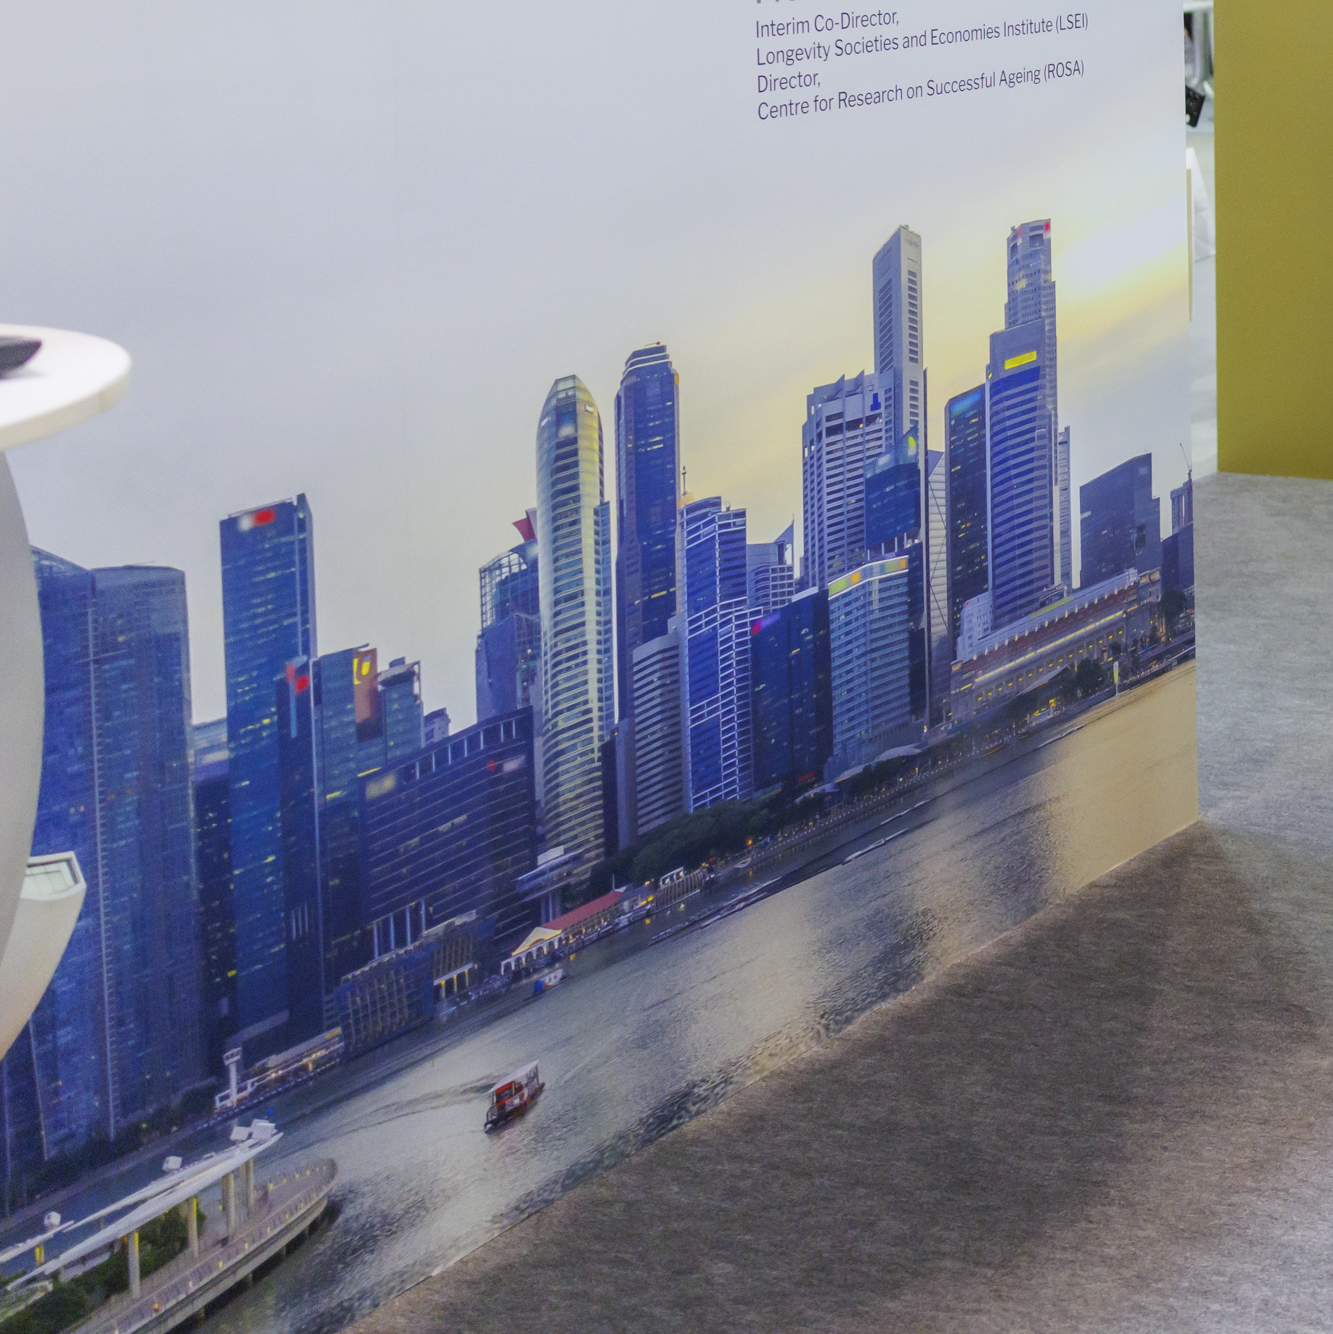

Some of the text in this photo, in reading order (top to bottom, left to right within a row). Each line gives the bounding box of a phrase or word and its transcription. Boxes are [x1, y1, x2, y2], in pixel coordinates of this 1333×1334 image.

[756, 9, 900, 38] Interim Co-Director,
[757, 41, 831, 66] Longevity
[834, 32, 899, 57] Societies
[902, 30, 927, 49] and
[930, 23, 1001, 46] Economies
[1003, 17, 1053, 37] Institute
[757, 70, 821, 94] Director,
[757, 60, 1085, 120] Centre for Research on Successful Ageing (ROSA)
